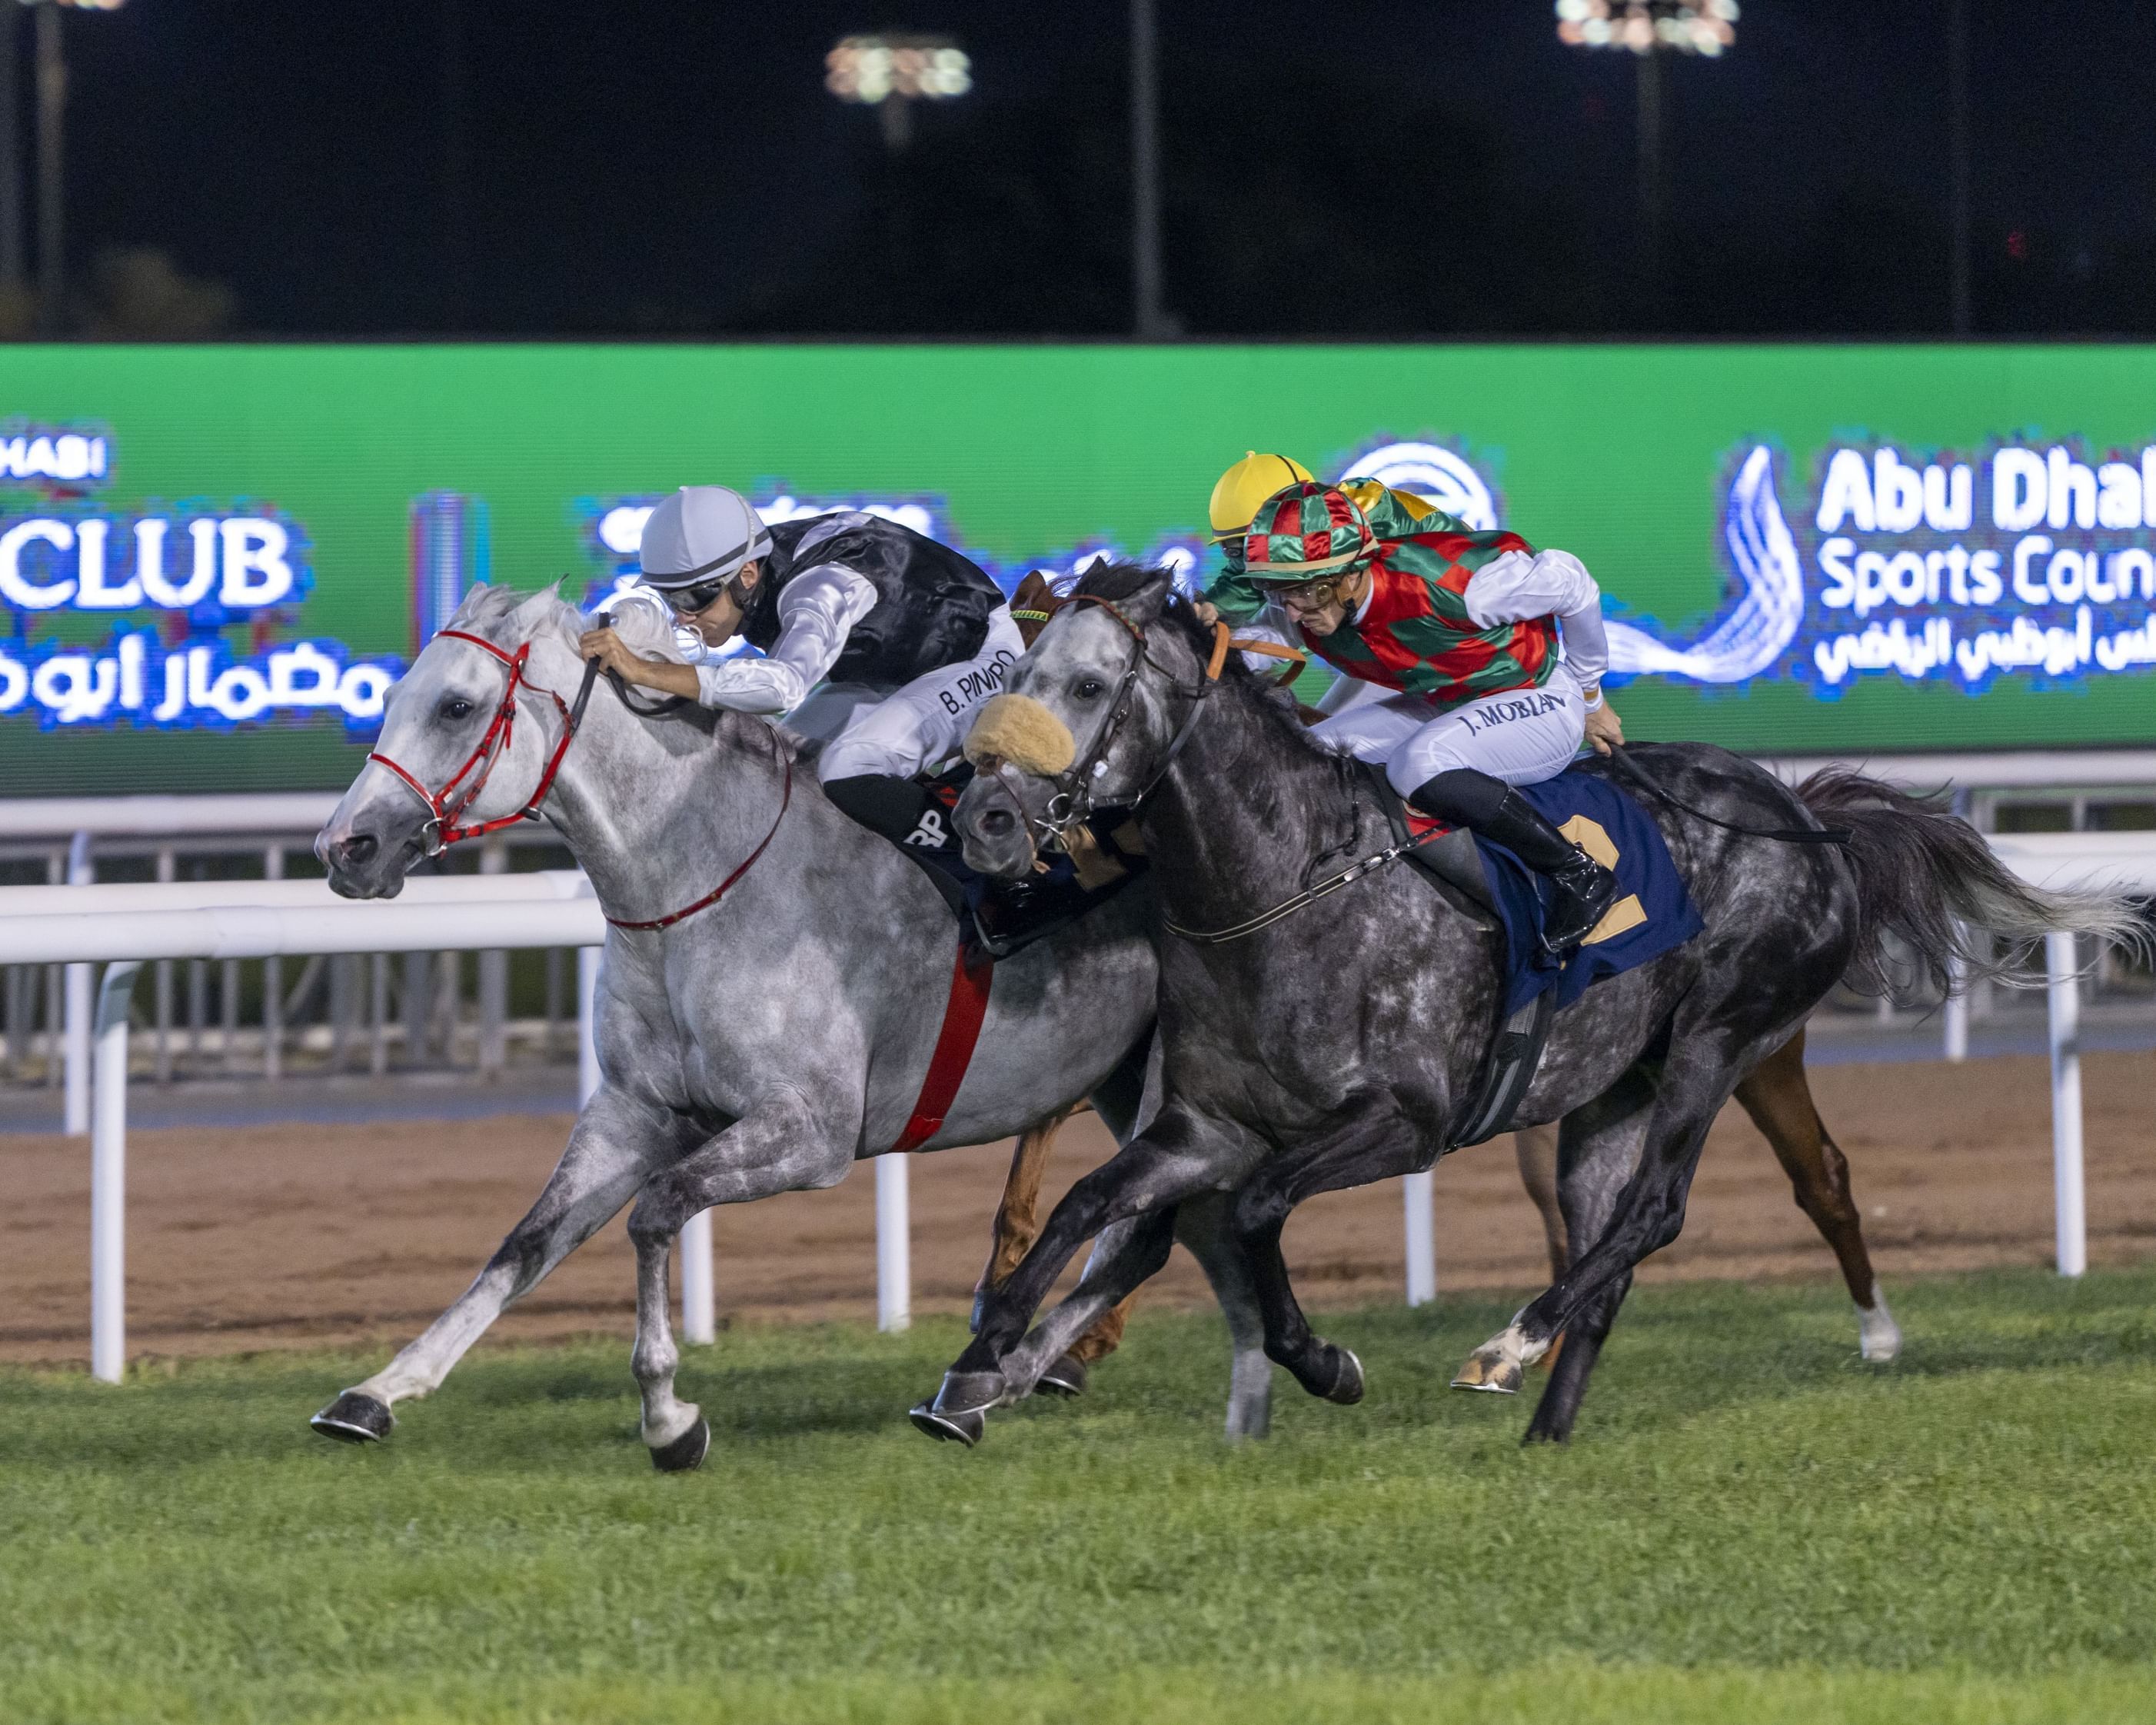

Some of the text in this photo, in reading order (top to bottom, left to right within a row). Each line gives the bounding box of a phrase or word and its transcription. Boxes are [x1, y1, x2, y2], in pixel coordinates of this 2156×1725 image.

[1816, 448, 1973, 531] Abu
[0, 518, 293, 608] CLUB
[1819, 535, 2156, 618] Sports Coun
[939, 691, 966, 715] B.
[1456, 700, 1482, 737] J.
